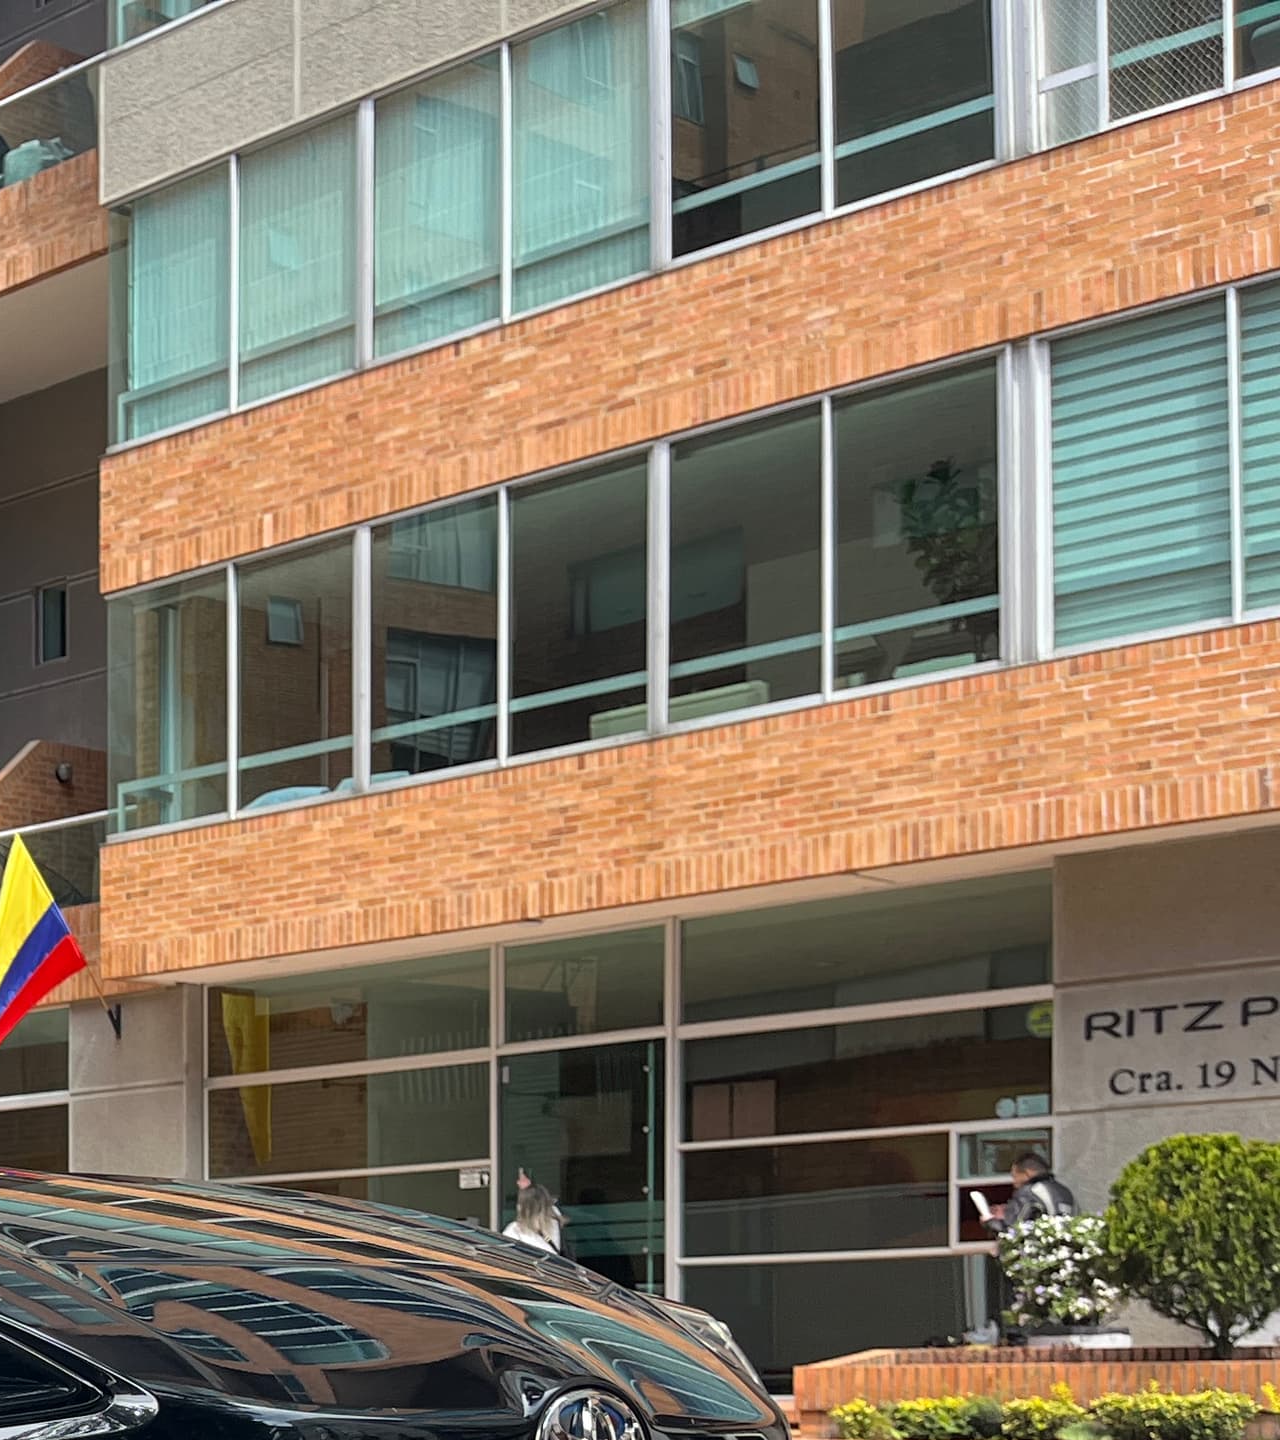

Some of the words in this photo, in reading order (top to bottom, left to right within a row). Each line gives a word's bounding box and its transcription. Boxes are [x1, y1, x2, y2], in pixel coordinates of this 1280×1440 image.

[1083, 1001, 1224, 1041] RITZ
[1109, 1067, 1183, 1096] Cra.
[1197, 1060, 1236, 1088] 19
